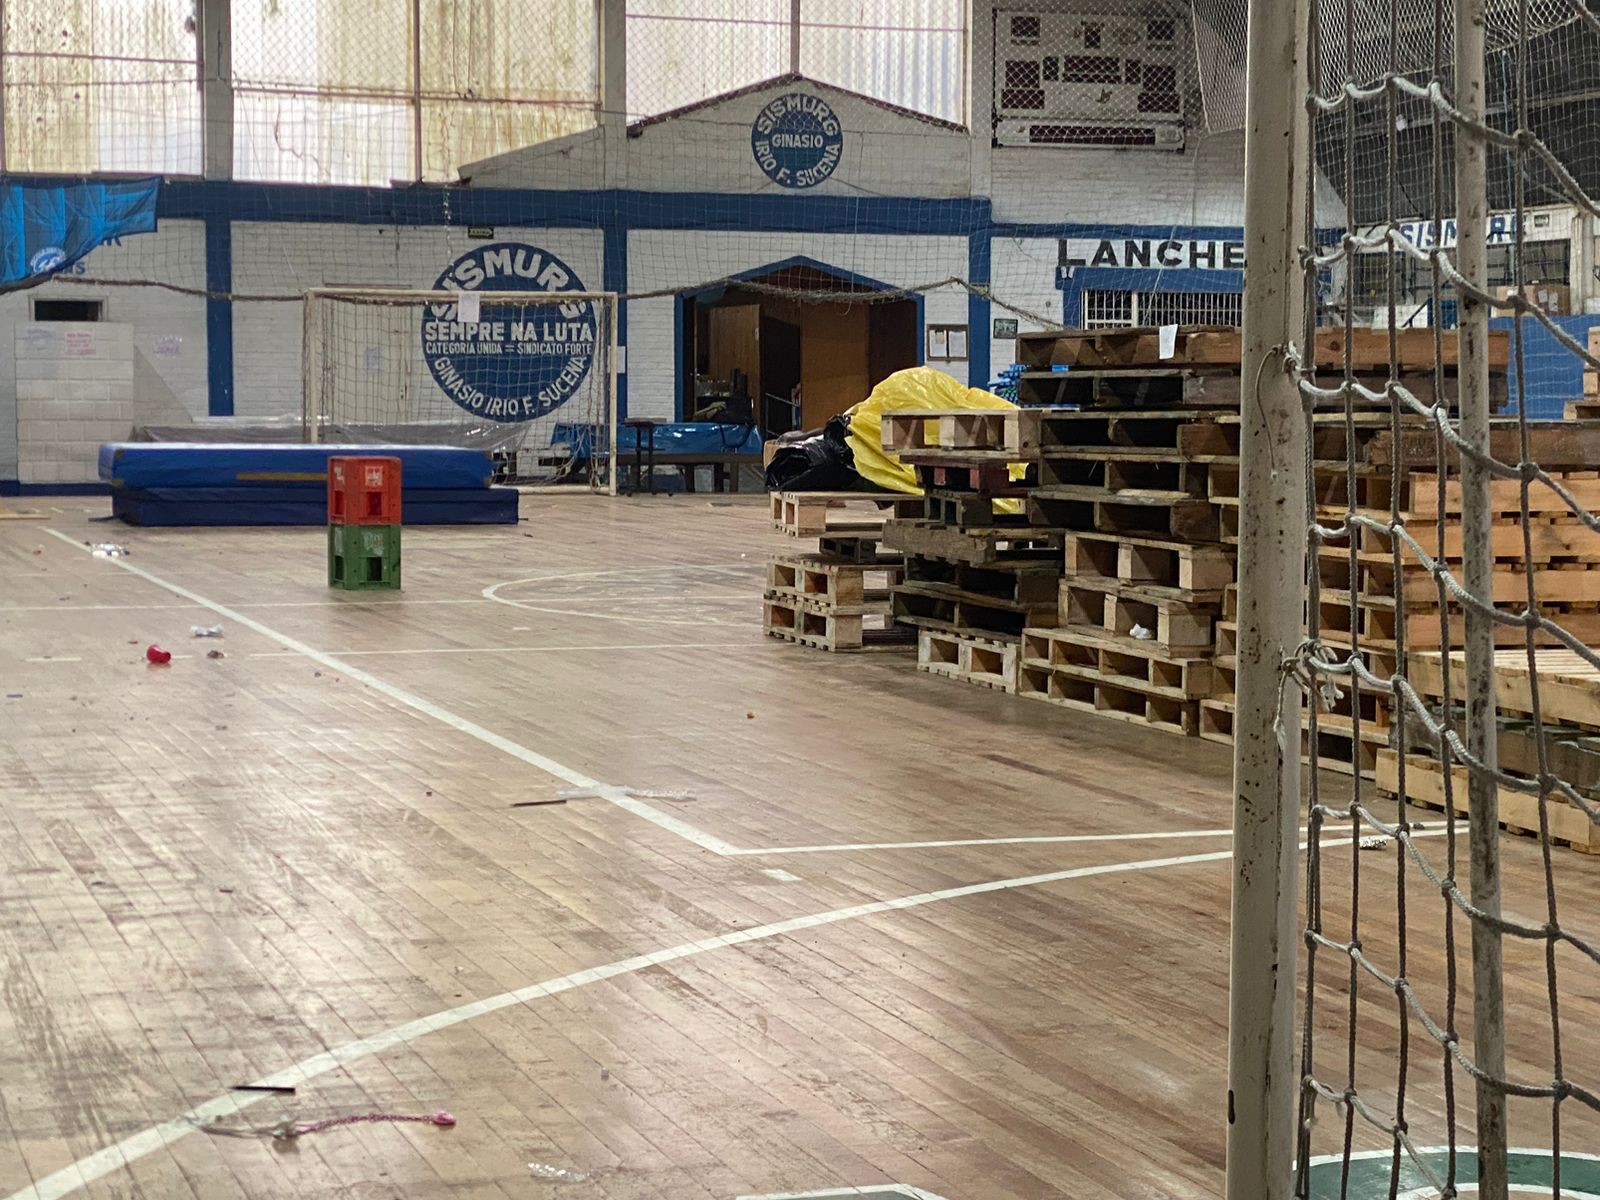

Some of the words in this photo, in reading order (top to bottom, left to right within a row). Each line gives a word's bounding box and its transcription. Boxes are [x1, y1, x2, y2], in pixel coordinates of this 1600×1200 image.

[757, 96, 839, 137] SISMURG
[771, 134, 824, 149] GINASIO
[755, 140, 777, 171] IRIO
[796, 143, 841, 186] SUCENA
[425, 321, 505, 341] SEMPRE
[511, 322, 538, 341] NA
[543, 322, 594, 342] LUTA
[425, 342, 476, 355] CATEGORIA
[477, 342, 503, 355] UNIDA
[517, 342, 564, 355] SINDICATO
[564, 342, 593, 355] FORTE
[434, 356, 484, 409] GINASIO
[485, 397, 519, 416] IRIO
[538, 356, 588, 407] SUCENA
